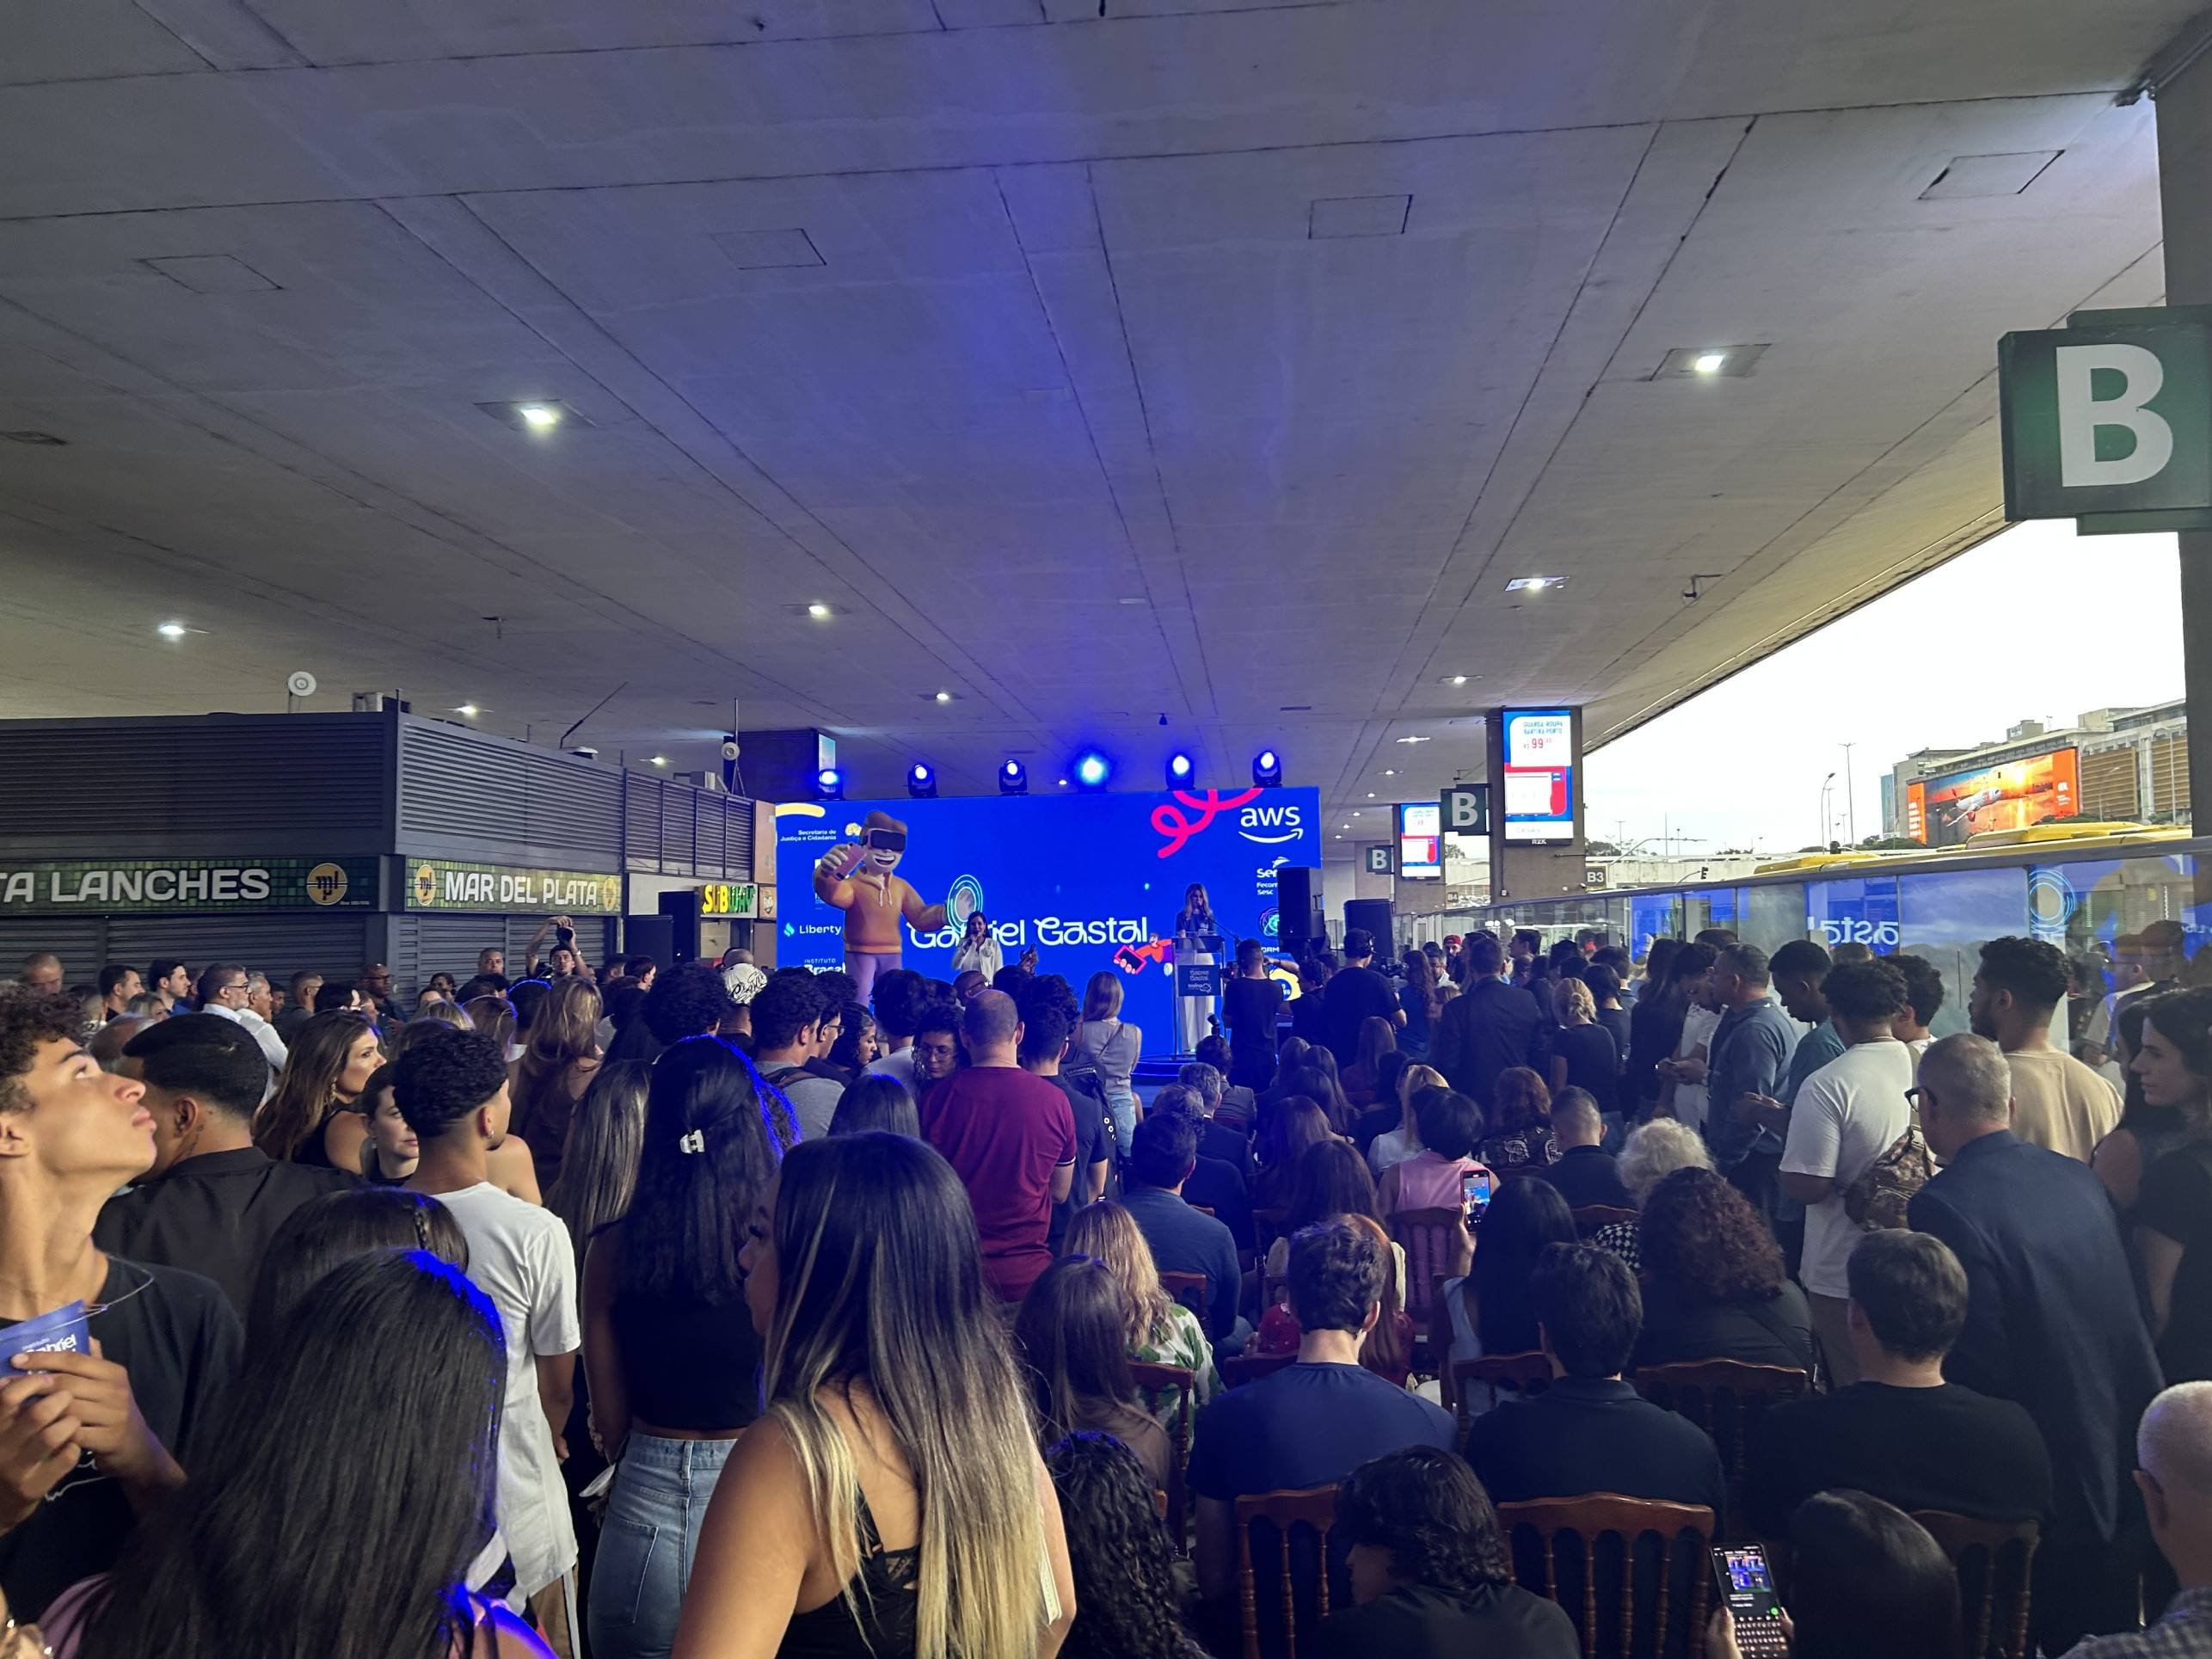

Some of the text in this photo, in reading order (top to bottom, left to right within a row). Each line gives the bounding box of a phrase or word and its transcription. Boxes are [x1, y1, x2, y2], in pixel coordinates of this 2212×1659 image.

[2055, 344, 2173, 488] B
[1240, 806, 1300, 827] aws
[1452, 792, 1478, 826] B
[1372, 849, 1387, 869] B
[51, 869, 270, 902] LANCHES
[445, 871, 598, 906] MAR DEL PLATA
[1587, 871, 1604, 882] B3
[702, 884, 755, 914] SUBWAY
[799, 925, 842, 936] Liberty
[906, 916, 1147, 949] Gaiel Gastal
